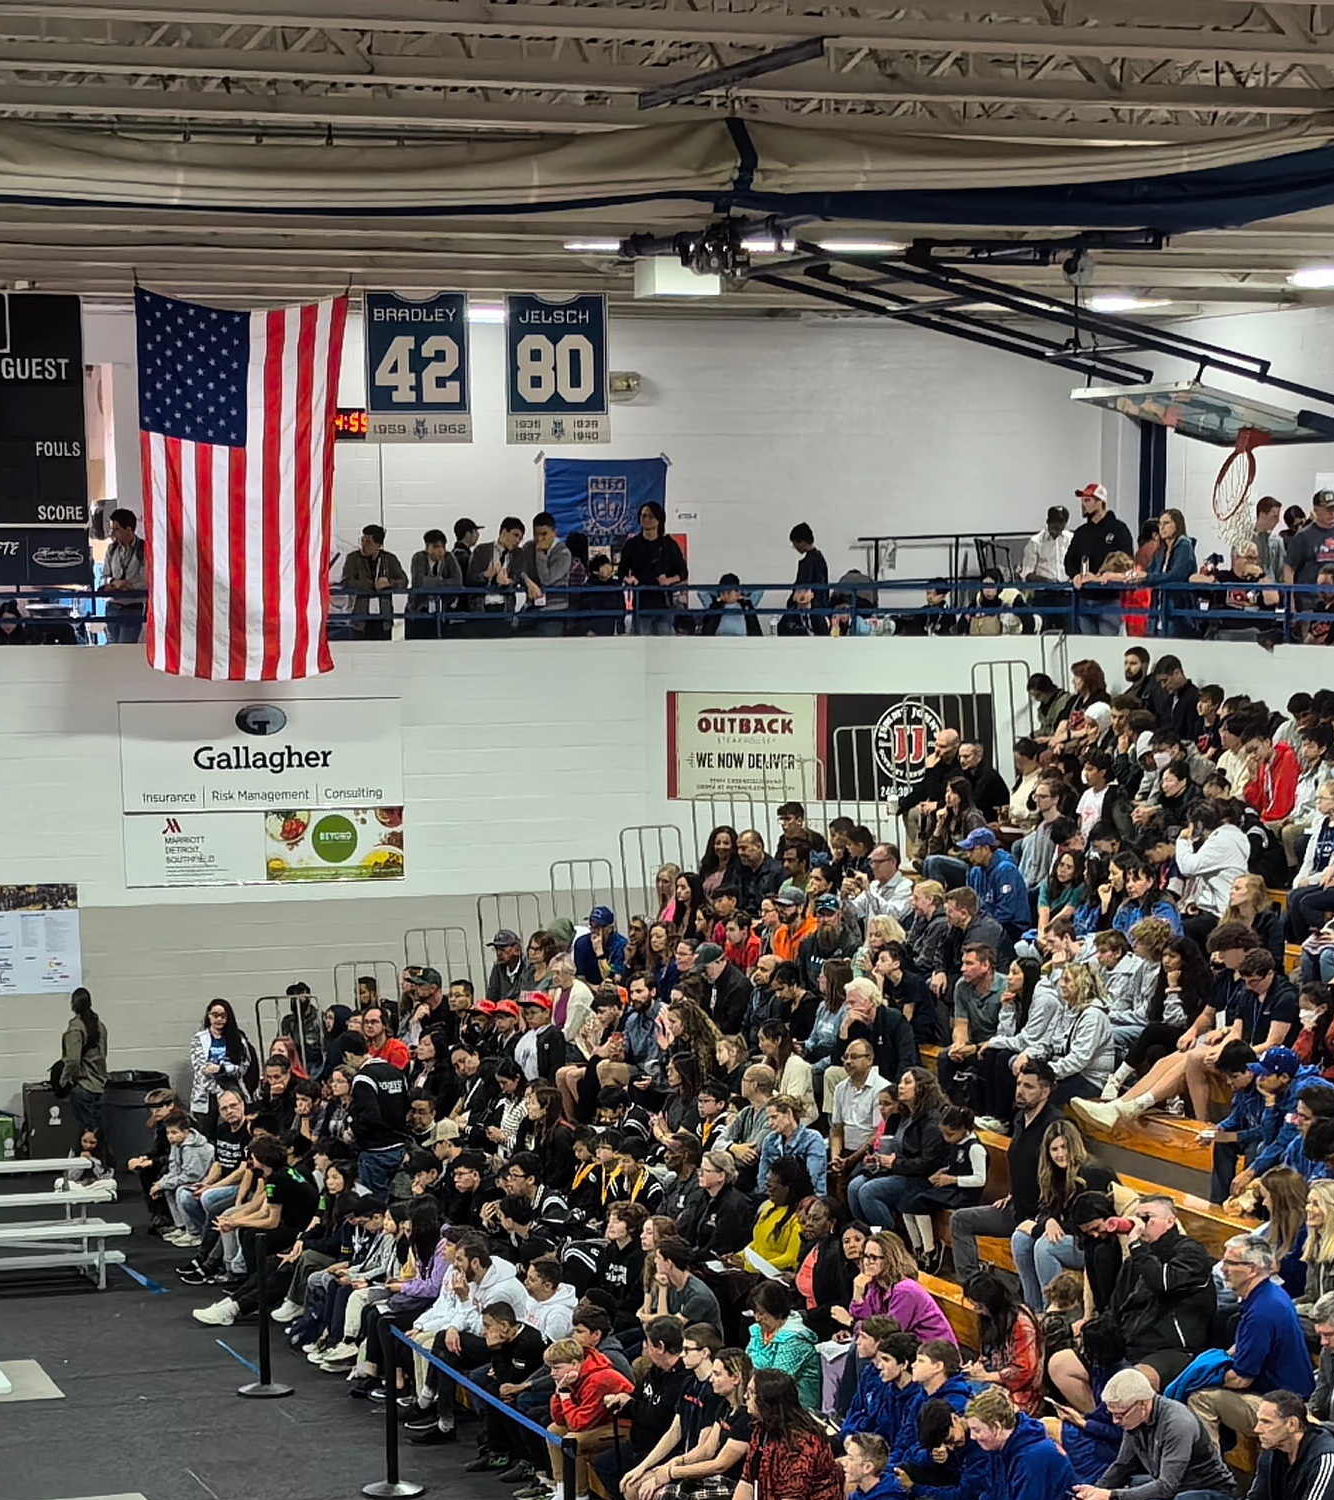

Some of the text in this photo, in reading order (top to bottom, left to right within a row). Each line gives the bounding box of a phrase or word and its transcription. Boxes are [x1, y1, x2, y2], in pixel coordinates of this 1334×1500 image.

[373, 307, 457, 323] BRADLEY
[519, 308, 589, 325] JELSCH
[1, 358, 70, 380] GUEST
[374, 335, 461, 403] 42
[517, 334, 595, 403] 80
[35, 441, 81, 457] FOULS
[37, 505, 84, 521] SCORE
[697, 717, 794, 734] OUTBACK
[193, 745, 332, 774] Gallagher
[696, 753, 796, 770] WE NOW DELIVER
[143, 787, 383, 803] Insurance Risk Management Consulting
